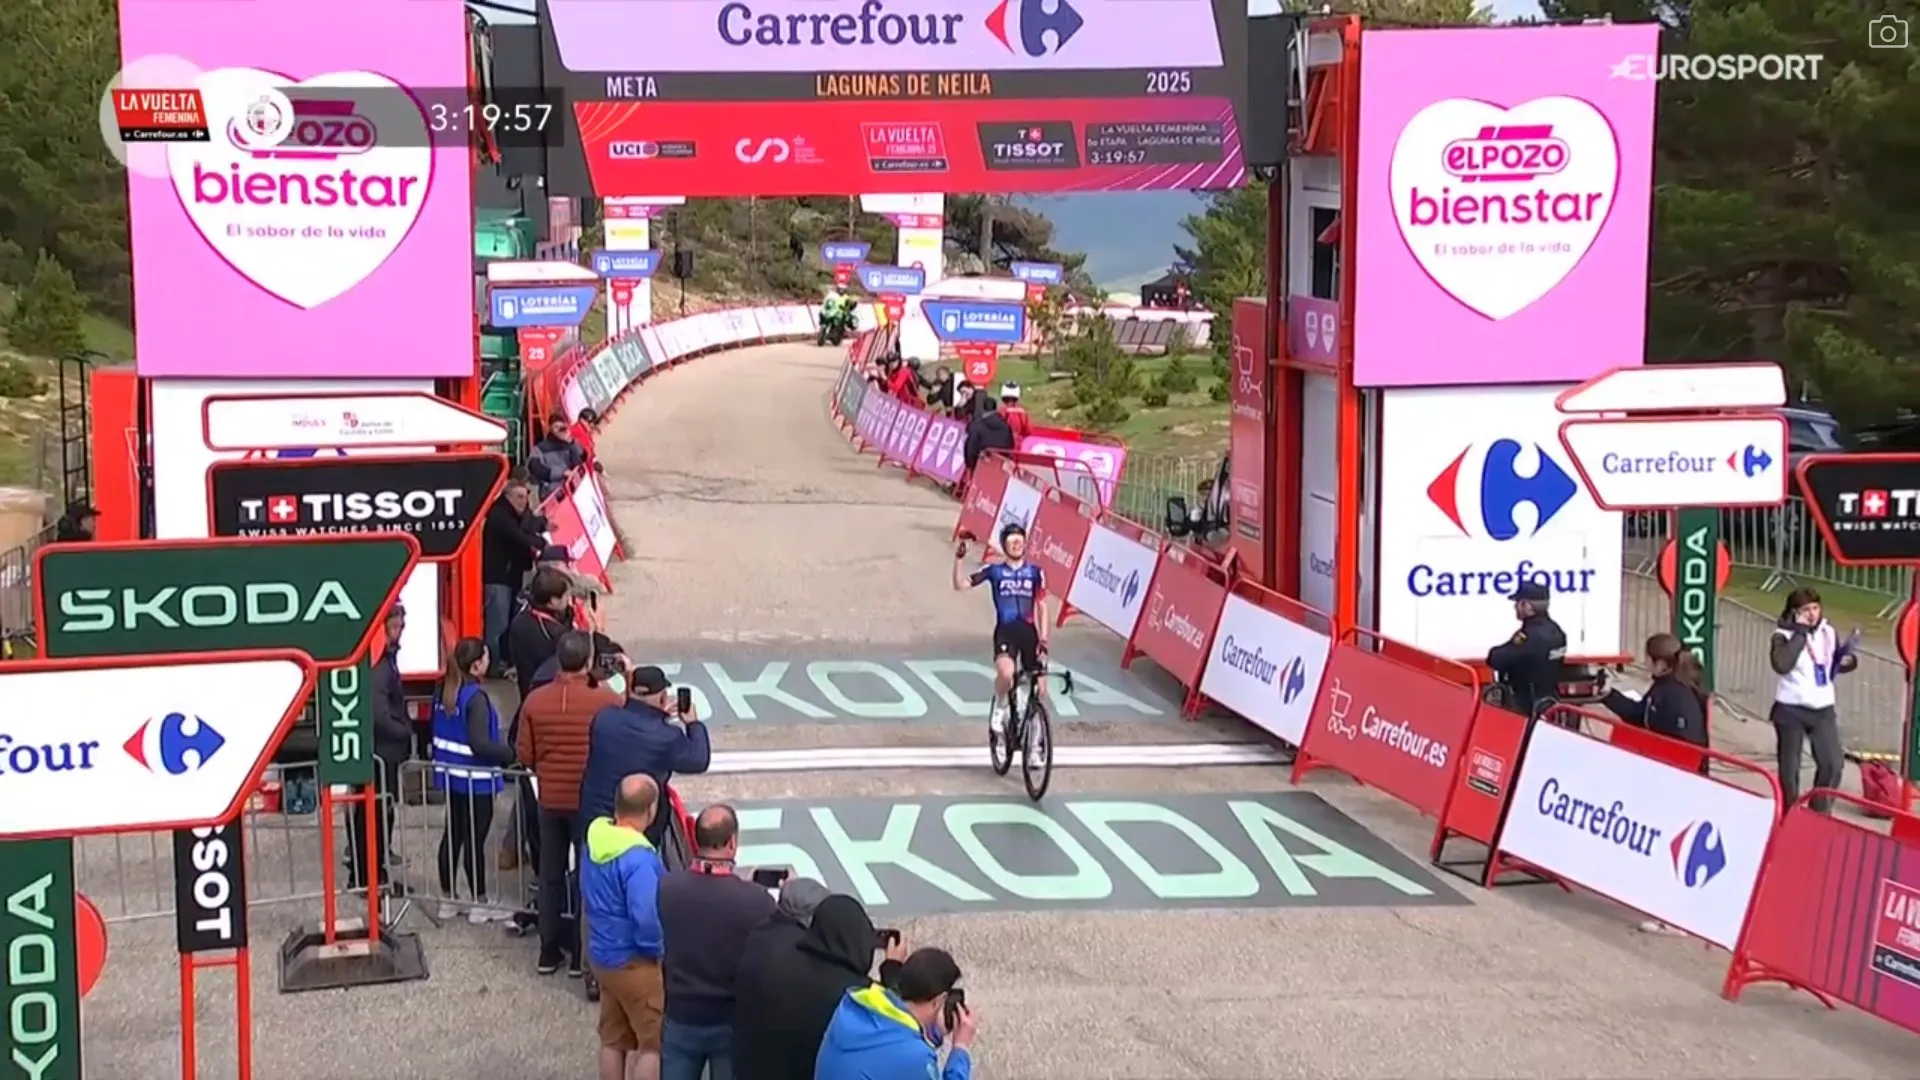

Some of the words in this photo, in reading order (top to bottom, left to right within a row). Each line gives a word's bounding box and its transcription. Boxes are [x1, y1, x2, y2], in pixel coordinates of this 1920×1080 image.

[717, 1, 963, 46] Carrefour
[606, 76, 658, 97] META
[816, 75, 900, 97] LAGUNAS
[906, 74, 931, 96] DE
[937, 73, 991, 95] NEILA
[1147, 71, 1191, 93] 2025
[887, 127, 935, 142] VUELTA
[612, 145, 641, 156] UCI
[993, 142, 1064, 157] TISSOT
[194, 163, 418, 207] bienstar
[1410, 187, 1603, 225] bienstar
[226, 224, 242, 238] El
[247, 223, 296, 238] sabor
[301, 223, 323, 239] de
[328, 223, 344, 239] la
[350, 223, 386, 239] vida
[527, 347, 545, 360] 25
[972, 361, 988, 376] 25
[1602, 451, 1716, 474] Carrefour
[241, 499, 263, 520] T
[302, 489, 463, 522] TISSOT
[296, 525, 368, 536] WATCHES
[376, 522, 423, 533] SINCE
[1407, 560, 1596, 597] Carrefour
[1222, 635, 1277, 686] Carrefour
[1361, 706, 1448, 768] Carrefour.es
[1537, 777, 1661, 857] Carrefour
